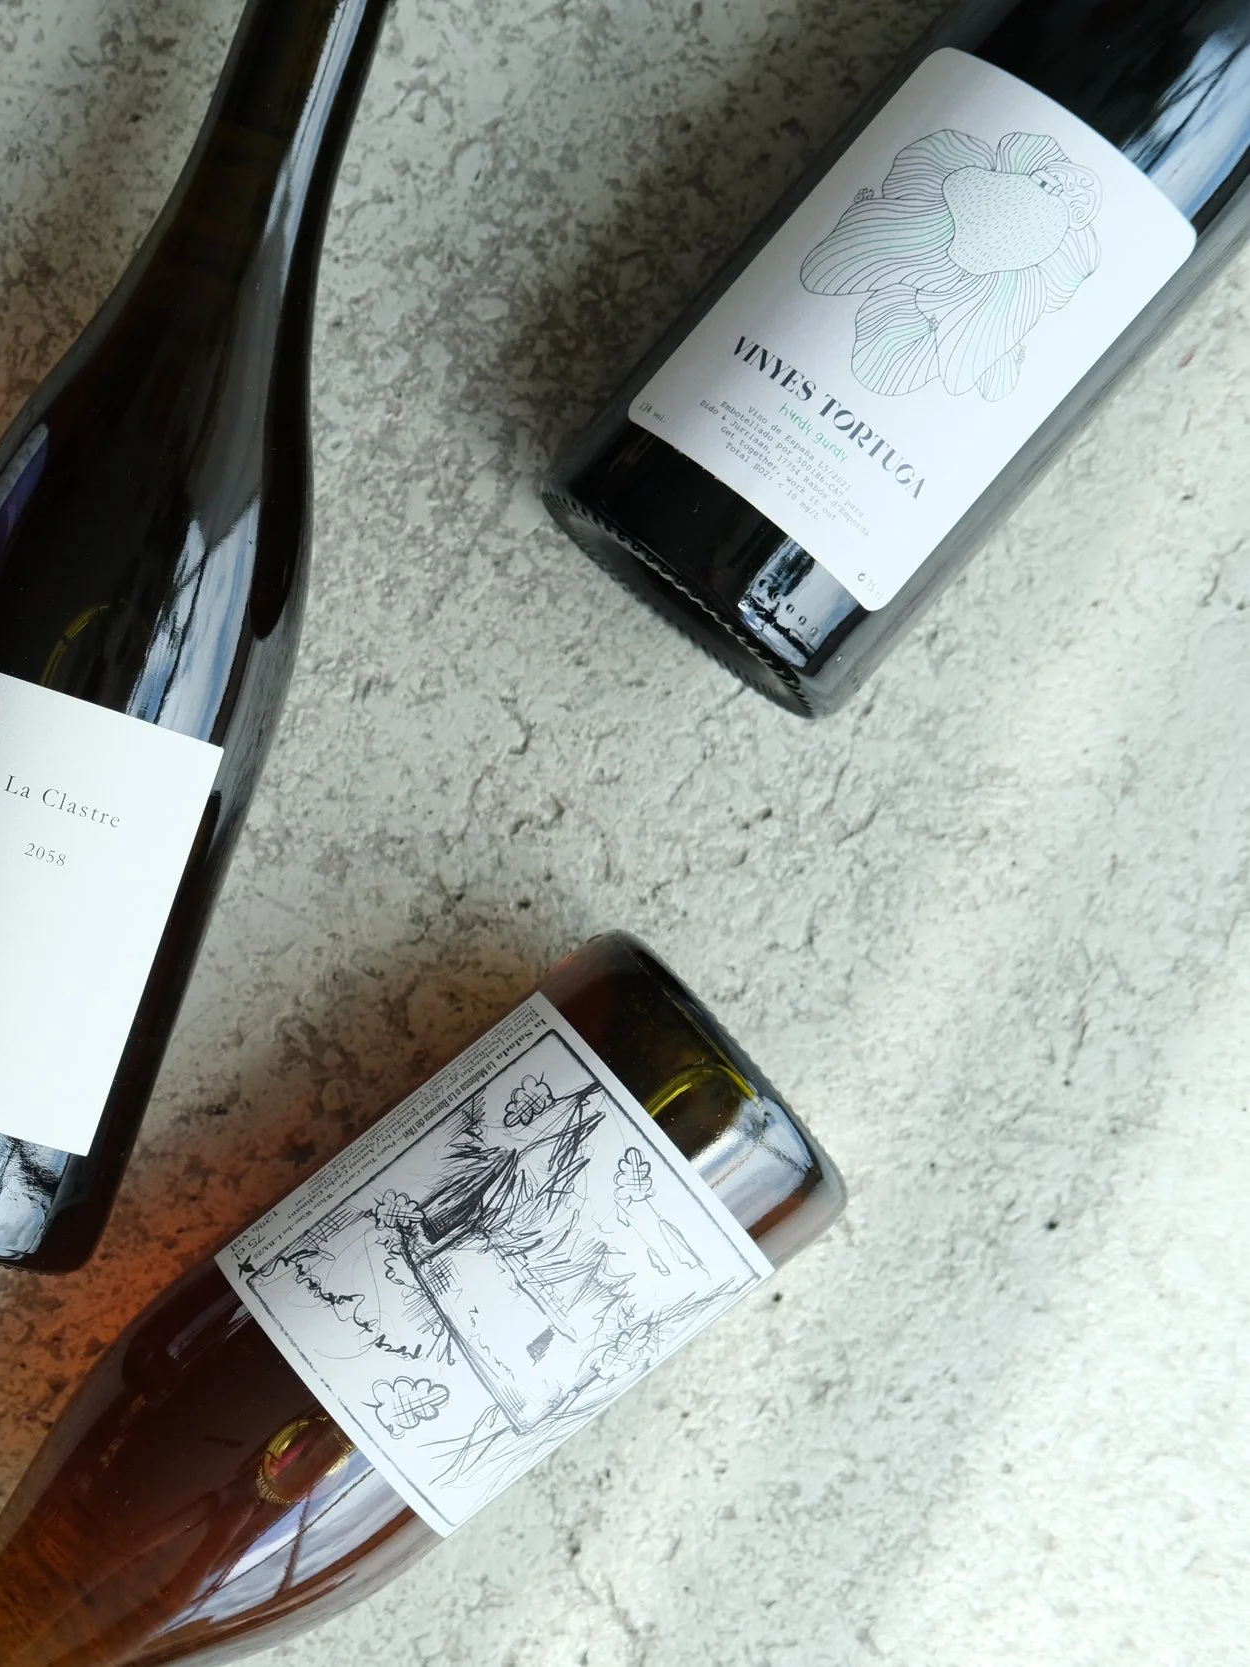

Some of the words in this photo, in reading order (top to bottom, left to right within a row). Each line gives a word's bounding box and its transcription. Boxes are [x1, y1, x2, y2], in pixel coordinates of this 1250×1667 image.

[699, 400, 718, 415] Dido
[733, 335, 817, 401] VINYES
[818, 393, 925, 500] TORTUGA
[748, 406, 768, 424] Vino
[770, 424, 782, 434] de
[785, 434, 815, 461] España
[720, 401, 774, 441] Embotellado
[776, 442, 792, 456] por
[844, 500, 864, 517] para
[726, 442, 750, 463] Total
[786, 489, 797, 501] 10
[720, 426, 735, 439] Get
[739, 440, 780, 474] together,
[786, 476, 806, 494] work
[810, 495, 819, 505] it
[822, 507, 836, 520] out
[2, 774, 30, 800] La
[41, 786, 122, 829] Clastre
[22, 842, 68, 868] 2058
[534, 1018, 546, 1030] la
[495, 1028, 534, 1062] Salada
[484, 1060, 496, 1072] La
[454, 1087, 462, 1095] o
[459, 1067, 488, 1093] Mulassa
[445, 1091, 457, 1103] La
[422, 1098, 450, 1123] Barraca
[414, 1117, 426, 1130] de
[250, 1209, 279, 1234] 12%
[247, 1231, 266, 1249] 75
